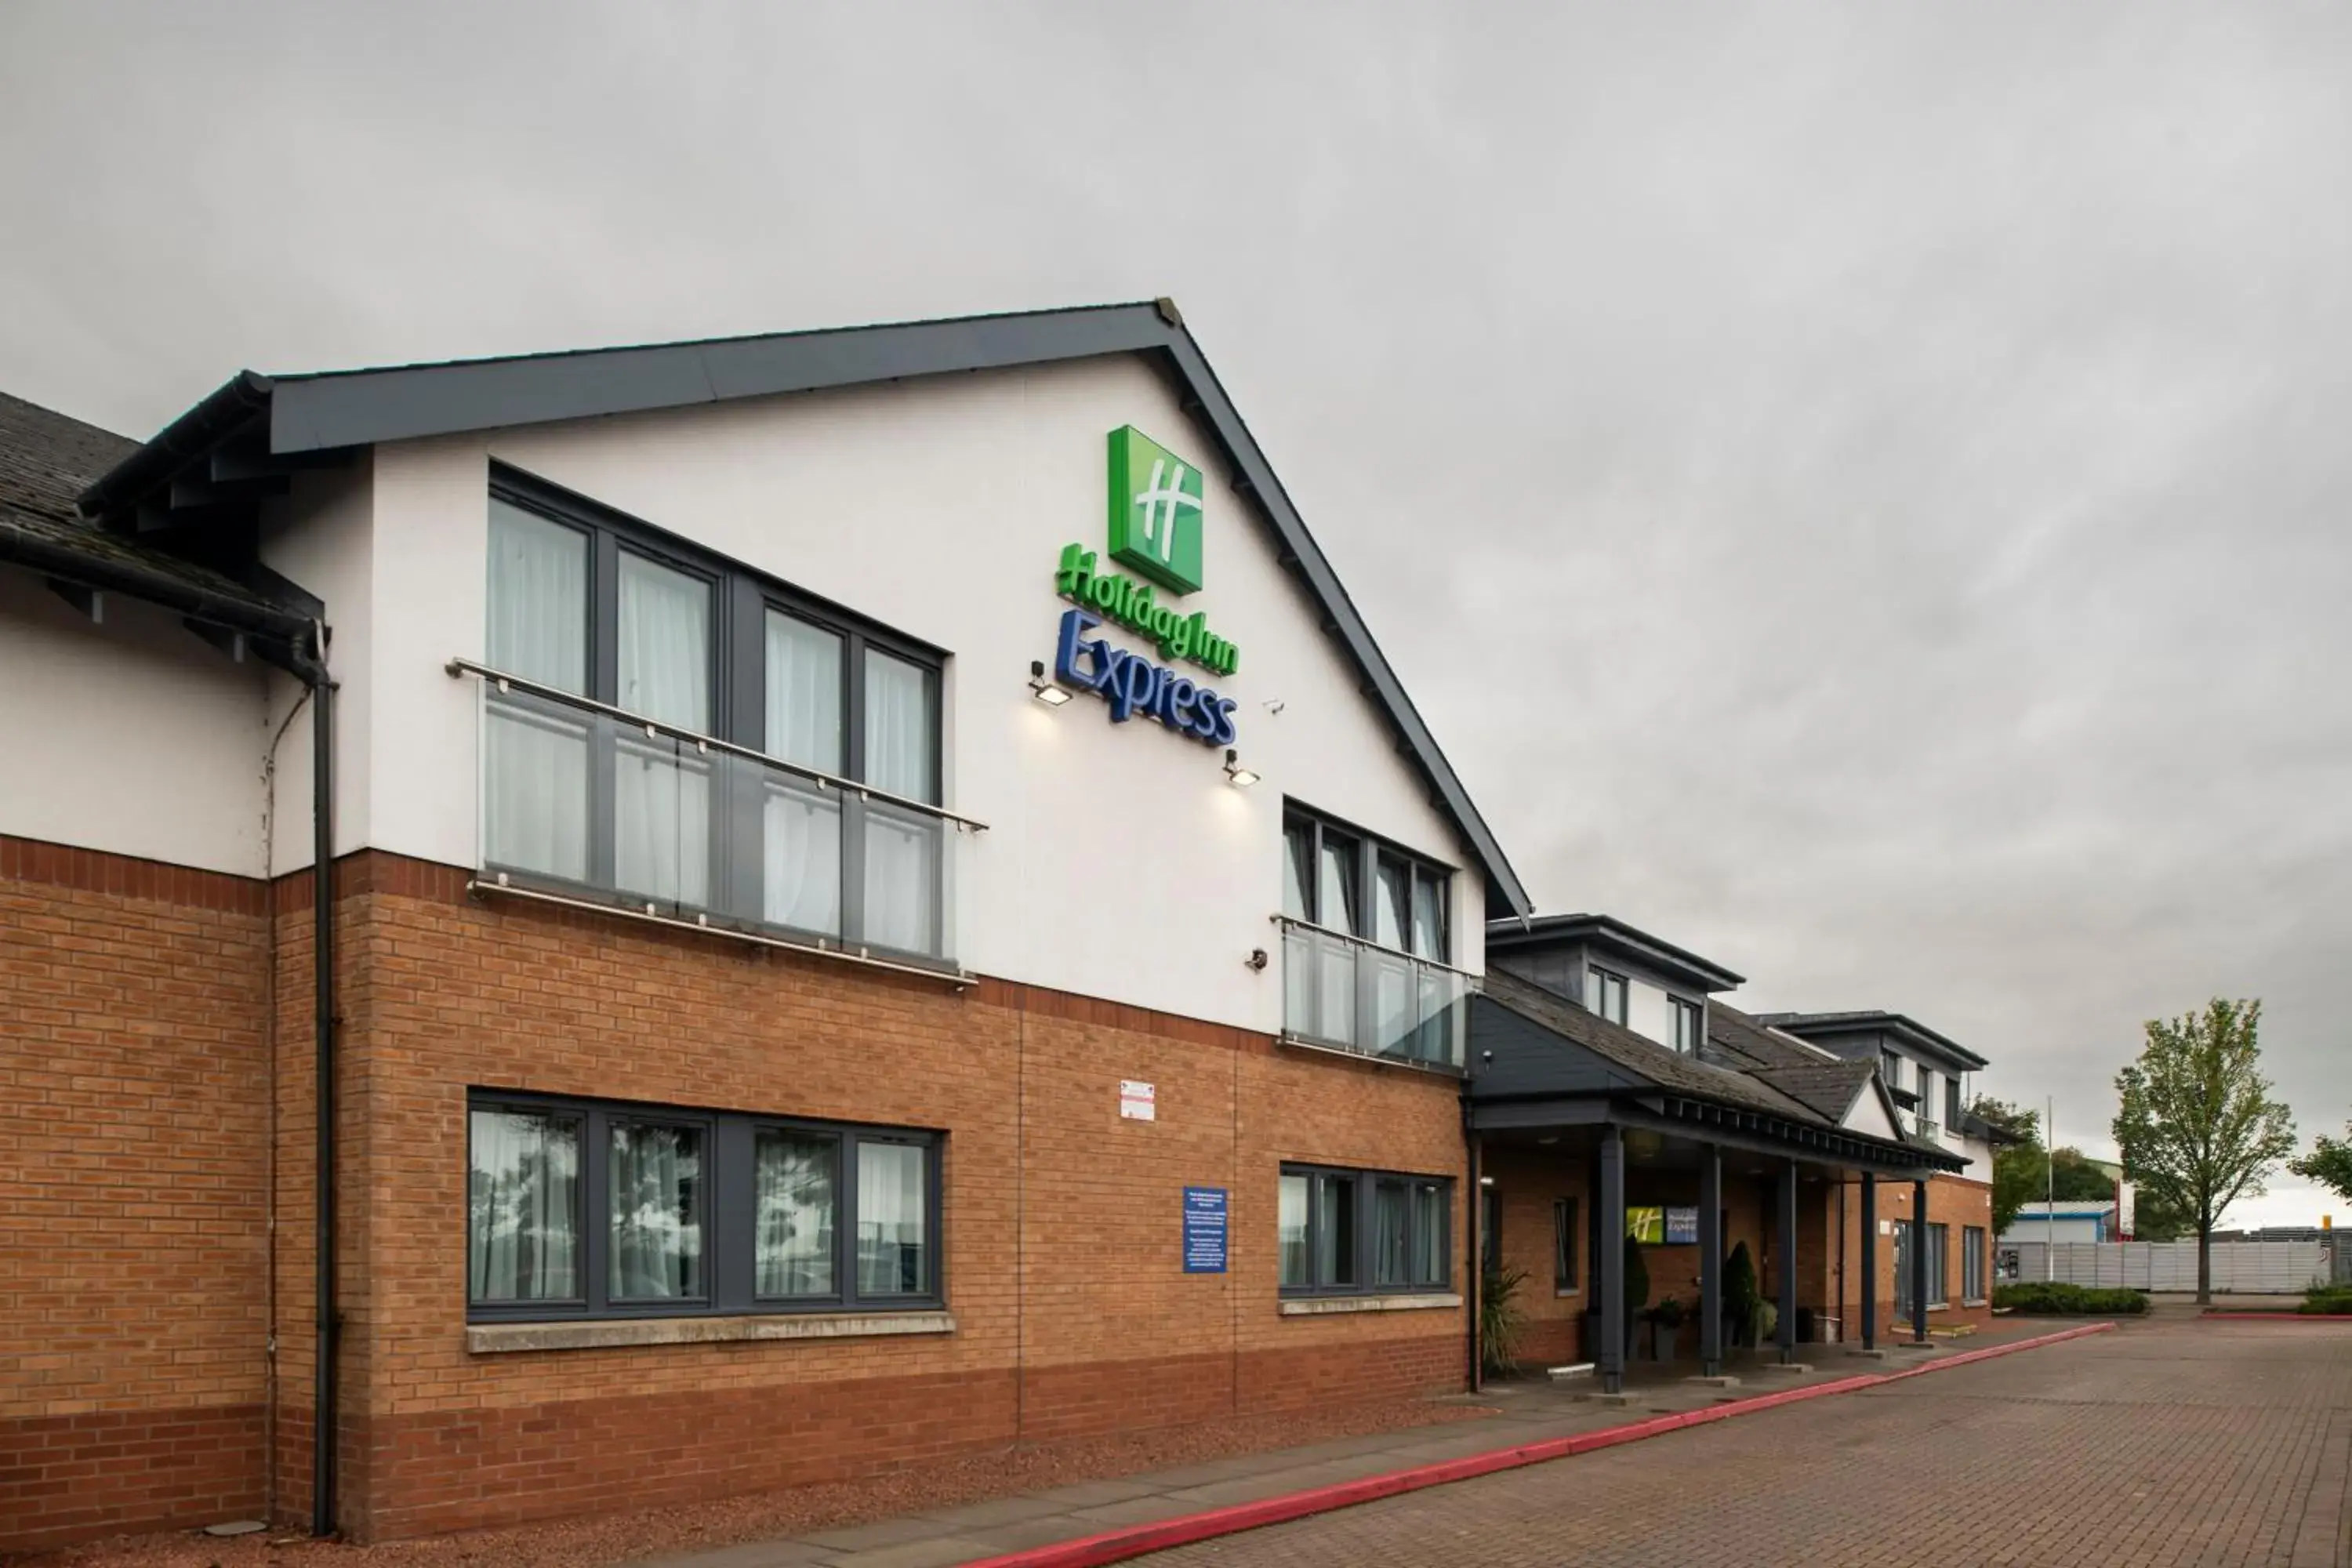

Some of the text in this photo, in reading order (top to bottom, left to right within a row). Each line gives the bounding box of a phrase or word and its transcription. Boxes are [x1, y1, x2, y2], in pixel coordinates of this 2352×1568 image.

[1055, 543, 1239, 677] Holiday Inn
[1055, 609, 1238, 746] Express
